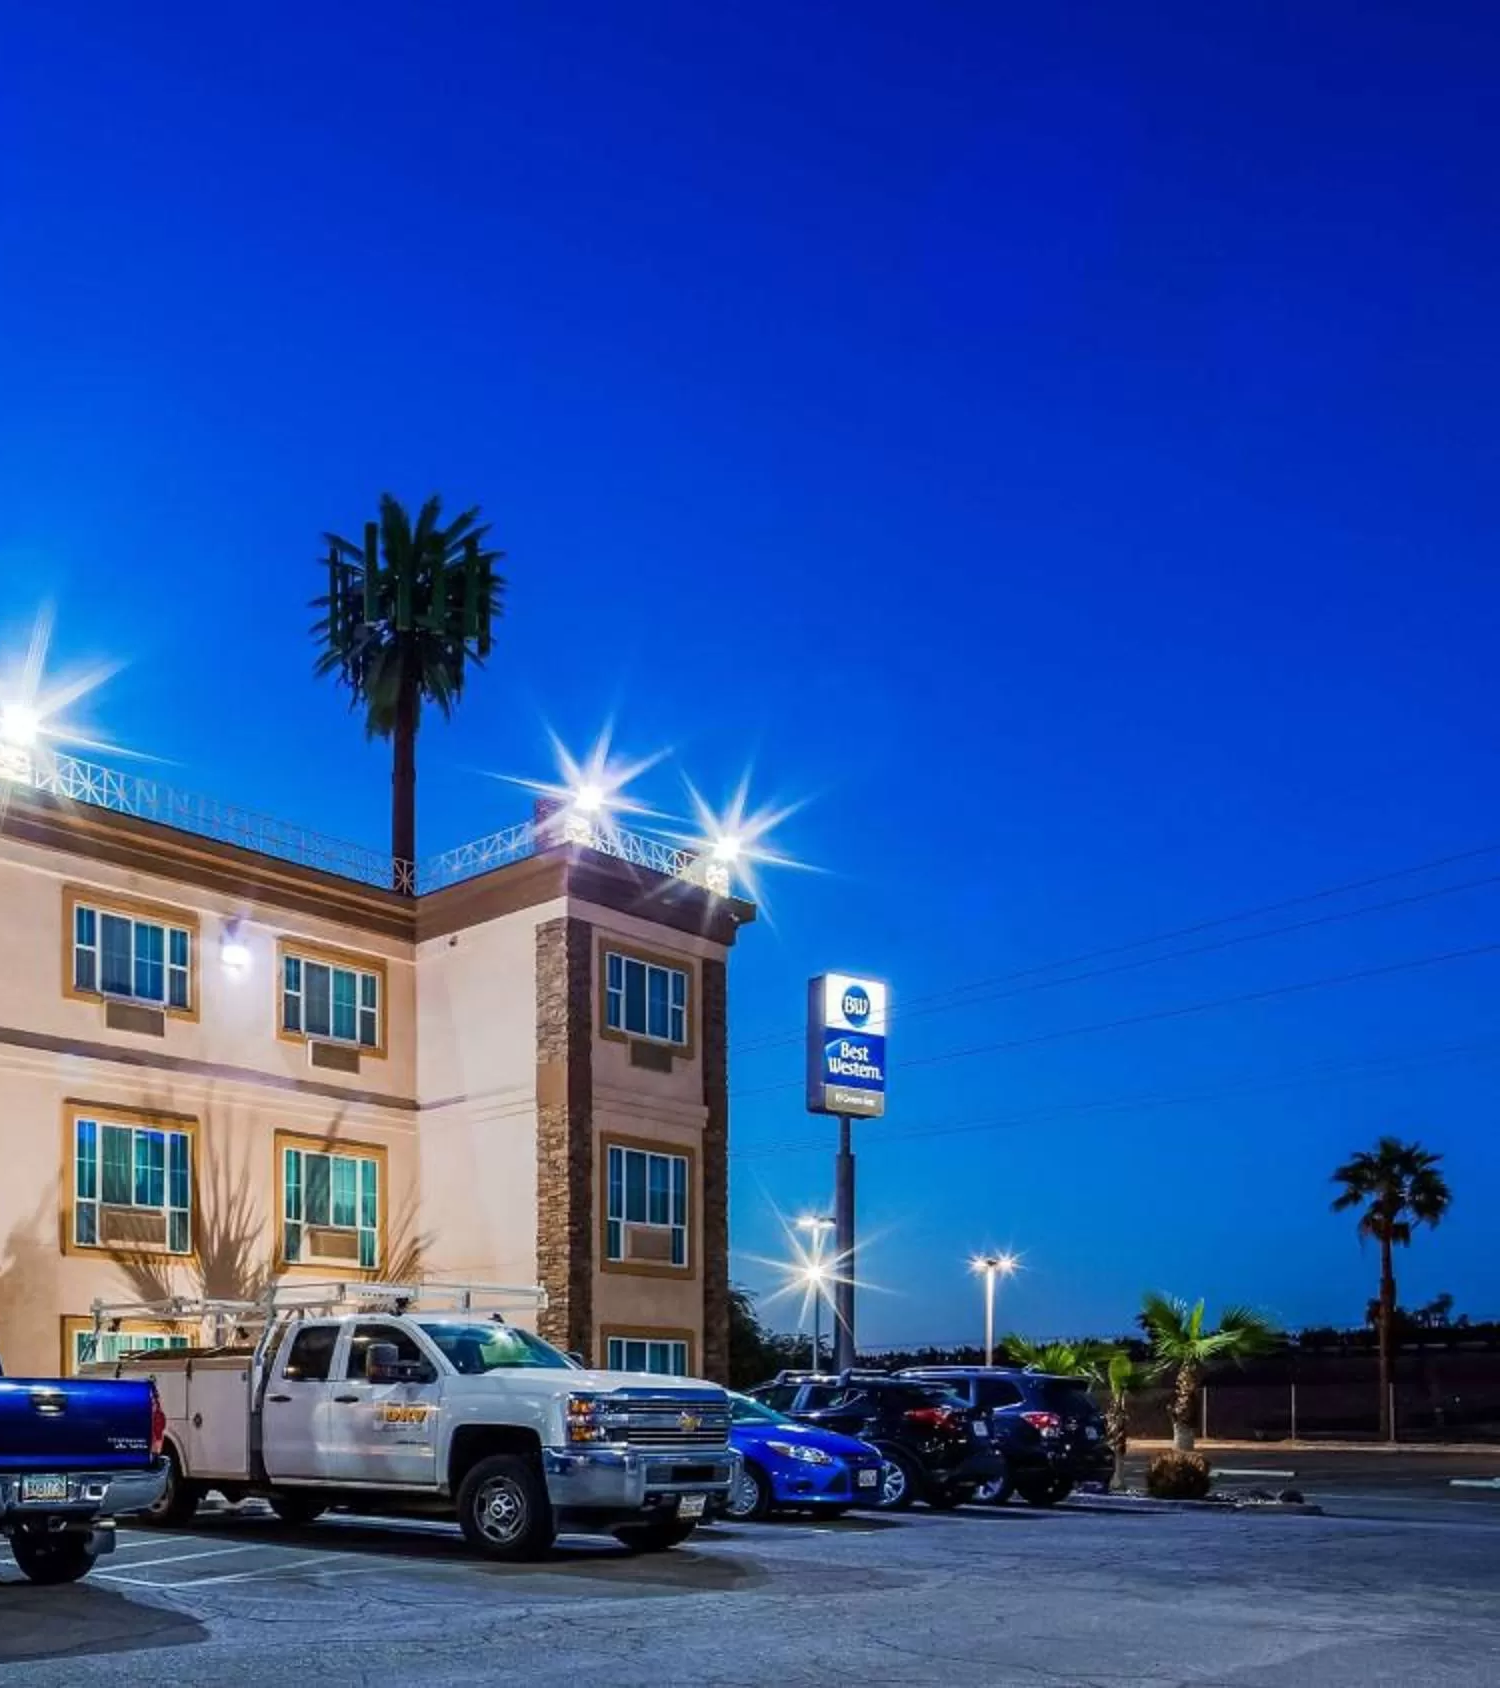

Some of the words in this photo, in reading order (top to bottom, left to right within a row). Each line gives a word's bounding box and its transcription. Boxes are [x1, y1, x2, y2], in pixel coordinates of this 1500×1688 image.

[844, 995, 868, 1015] BW
[841, 1041, 869, 1061] Best
[828, 1057, 880, 1080] Western
